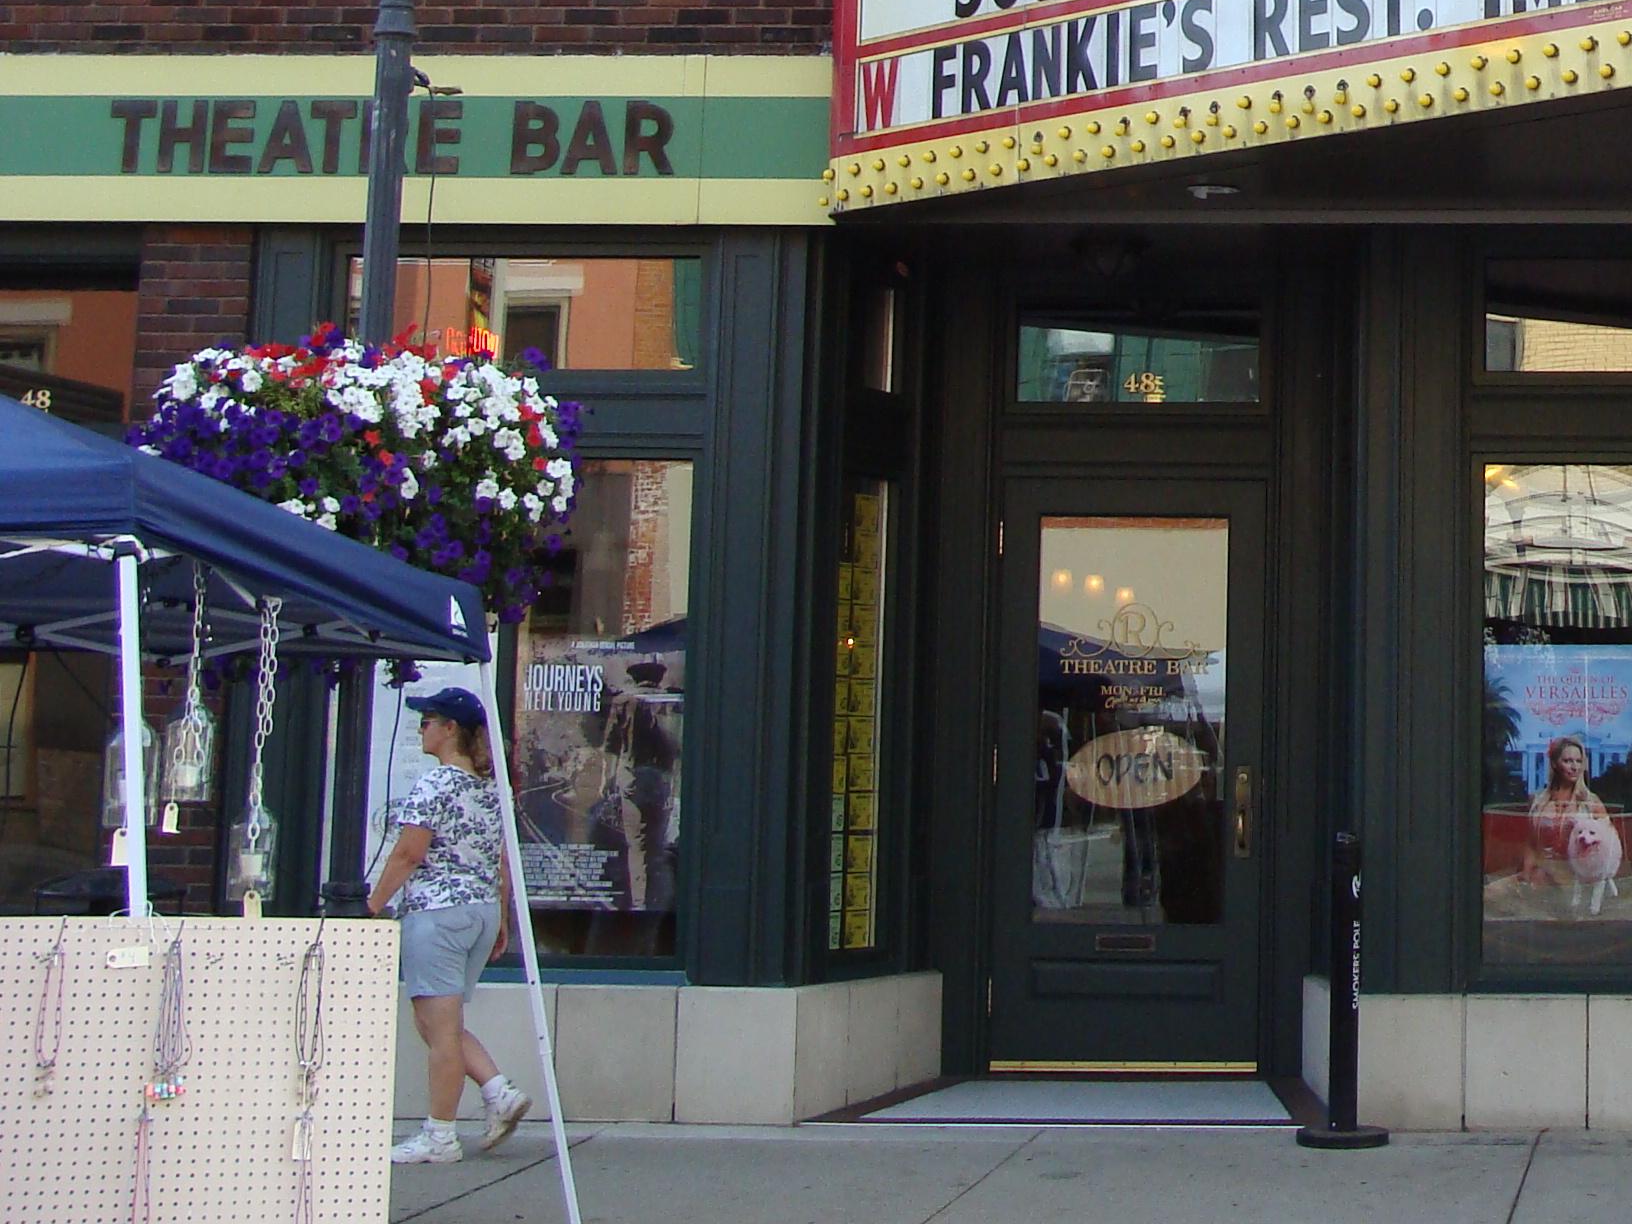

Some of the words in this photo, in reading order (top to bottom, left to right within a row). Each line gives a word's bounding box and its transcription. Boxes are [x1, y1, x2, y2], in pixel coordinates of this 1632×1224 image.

[862, 64, 899, 133] W
[931, 1, 1215, 120] FRANKIE'S
[111, 99, 464, 174] THEATE
[511, 100, 675, 175] BAR
[1123, 373, 1155, 393] 48
[1117, 612, 1147, 644] R
[523, 664, 604, 692] JOURNEYS
[1060, 659, 1157, 674] THEATRE
[524, 692, 553, 711] NEIL
[557, 691, 601, 712] YOUNG
[1525, 685, 1628, 699] VERSAILLES
[1096, 752, 1175, 785] OPEN
[1353, 921, 1361, 949] POLE
[1352, 950, 1361, 1010] SMOKERS
